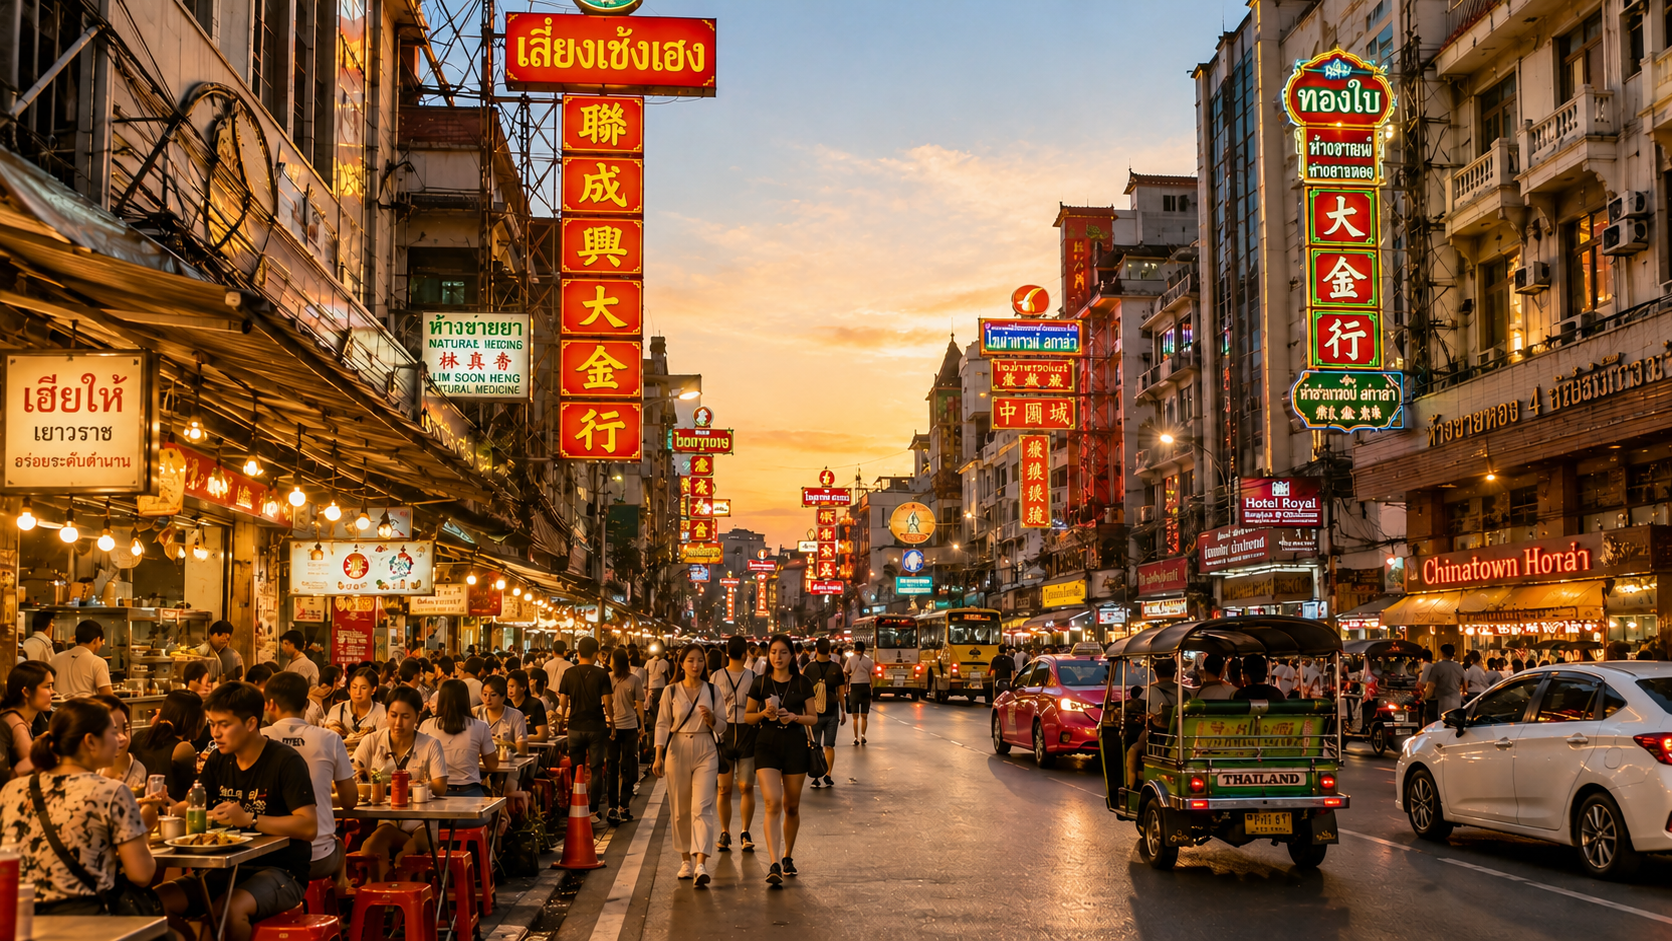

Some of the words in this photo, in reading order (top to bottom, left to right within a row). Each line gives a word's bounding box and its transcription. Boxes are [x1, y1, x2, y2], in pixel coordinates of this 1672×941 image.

[1297, 79, 1381, 113] ทองใบ
[1322, 195, 1368, 361] 大金行
[432, 373, 450, 382] LIM
[454, 373, 486, 383] SOON
[489, 374, 521, 383] HENG
[475, 385, 521, 395] MEDICINE
[23, 373, 127, 413] เฮียให้
[1528, 386, 1542, 416] 4
[33, 424, 113, 442] เยาวราช
[1245, 497, 1278, 508] Hotel
[1282, 497, 1316, 511] Royal
[1423, 555, 1520, 585] Chinatown
[1222, 773, 1300, 785] THAILAND
